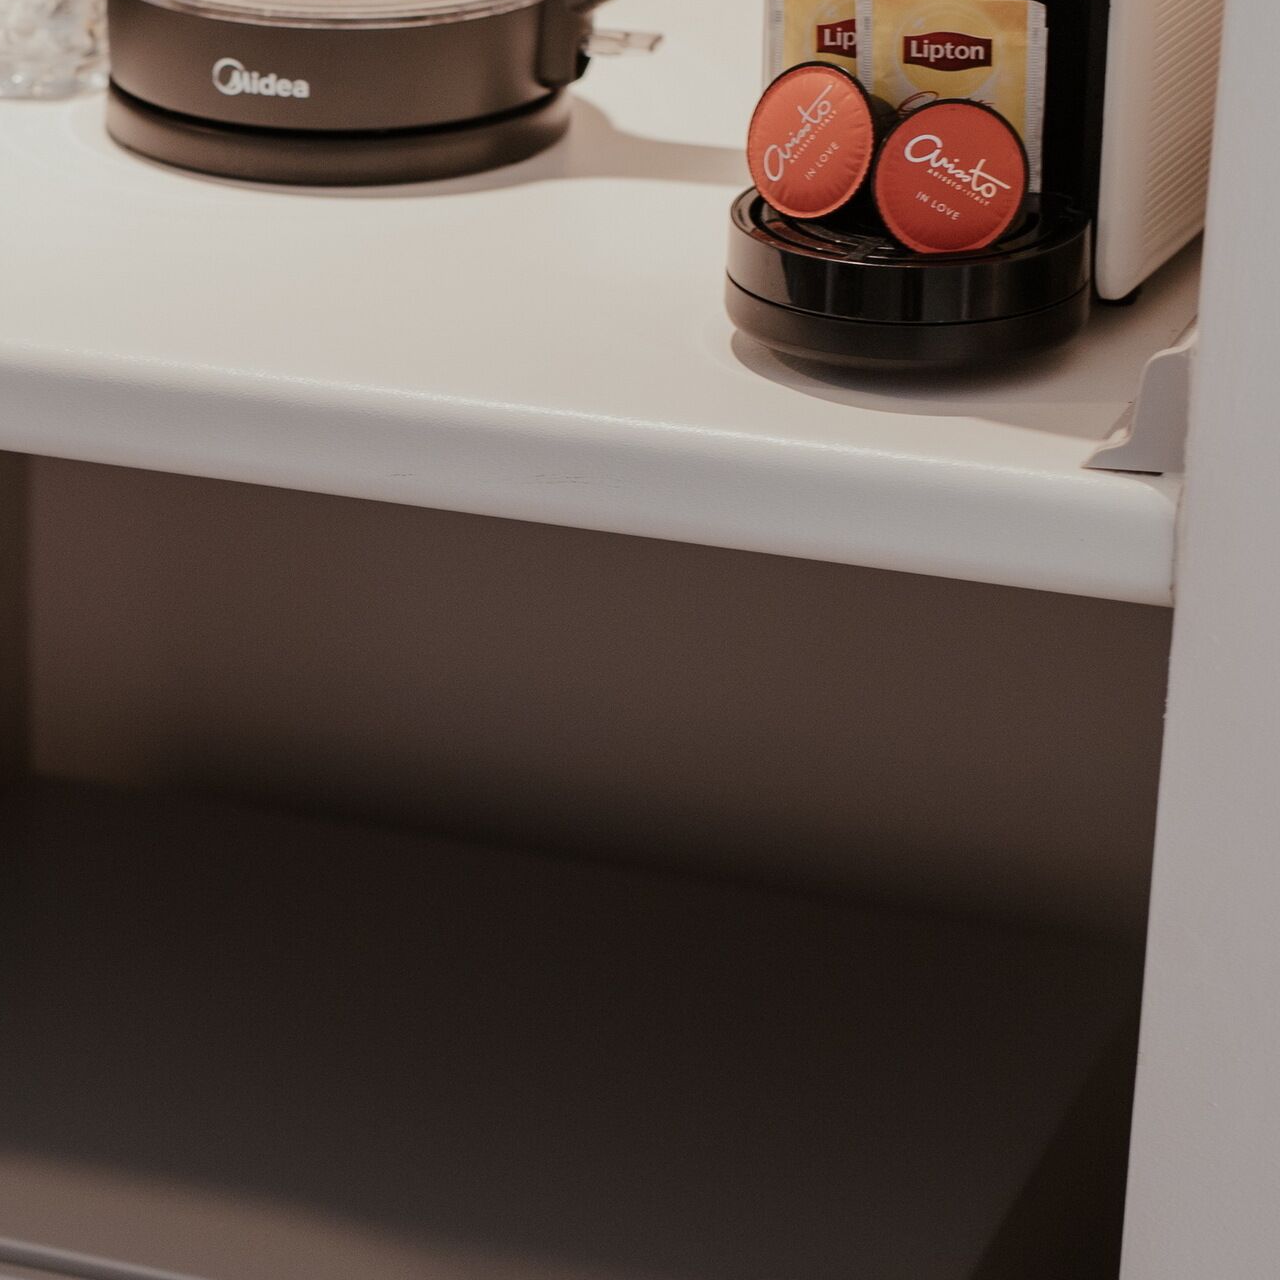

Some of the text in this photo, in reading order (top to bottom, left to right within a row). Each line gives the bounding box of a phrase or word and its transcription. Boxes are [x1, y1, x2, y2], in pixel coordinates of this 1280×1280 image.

[910, 39, 985, 62] Lipton
[212, 57, 309, 98] Midea
[804, 142, 840, 180] IN LOVE
[915, 191, 960, 220] IN LOVE
